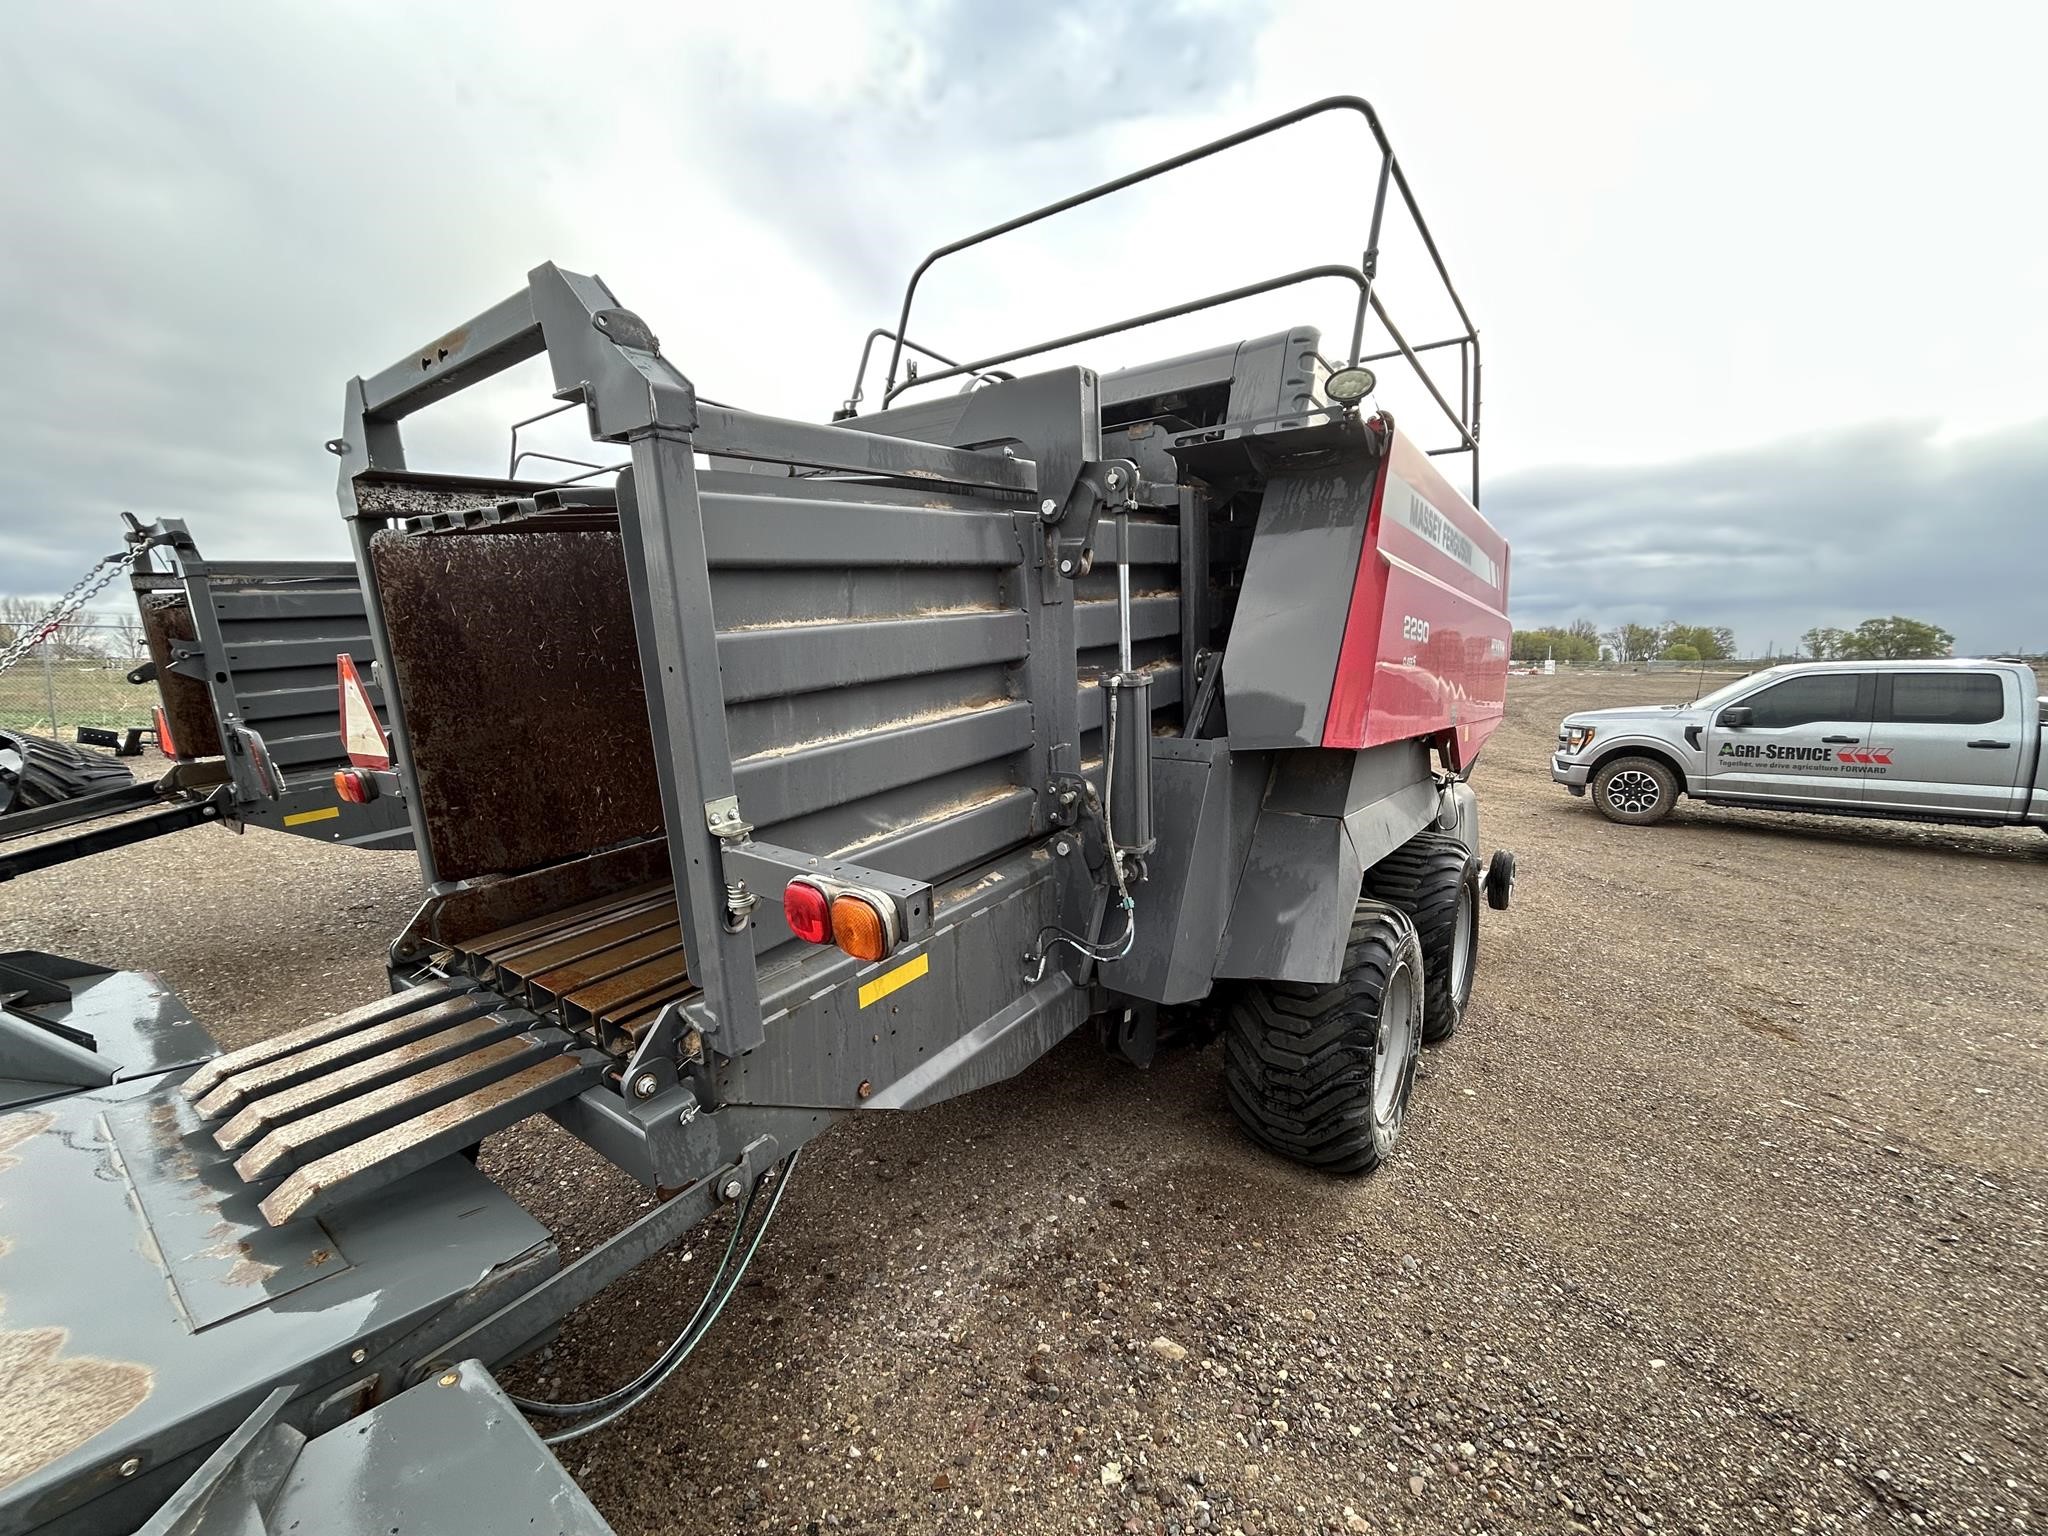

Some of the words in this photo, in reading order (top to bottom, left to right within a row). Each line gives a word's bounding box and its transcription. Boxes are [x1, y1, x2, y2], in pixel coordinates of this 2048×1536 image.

[1409, 494, 1442, 544] MASSEY
[1442, 520, 1473, 567] FERGUSON
[1403, 615, 1430, 644] 2290
[1718, 742, 1832, 761] AGRI-SERVICE
[1719, 759, 1754, 768] Together,
[1769, 761, 1790, 769] drive
[1791, 763, 1839, 772] agriculture
[1840, 765, 1887, 774] FORWARD
